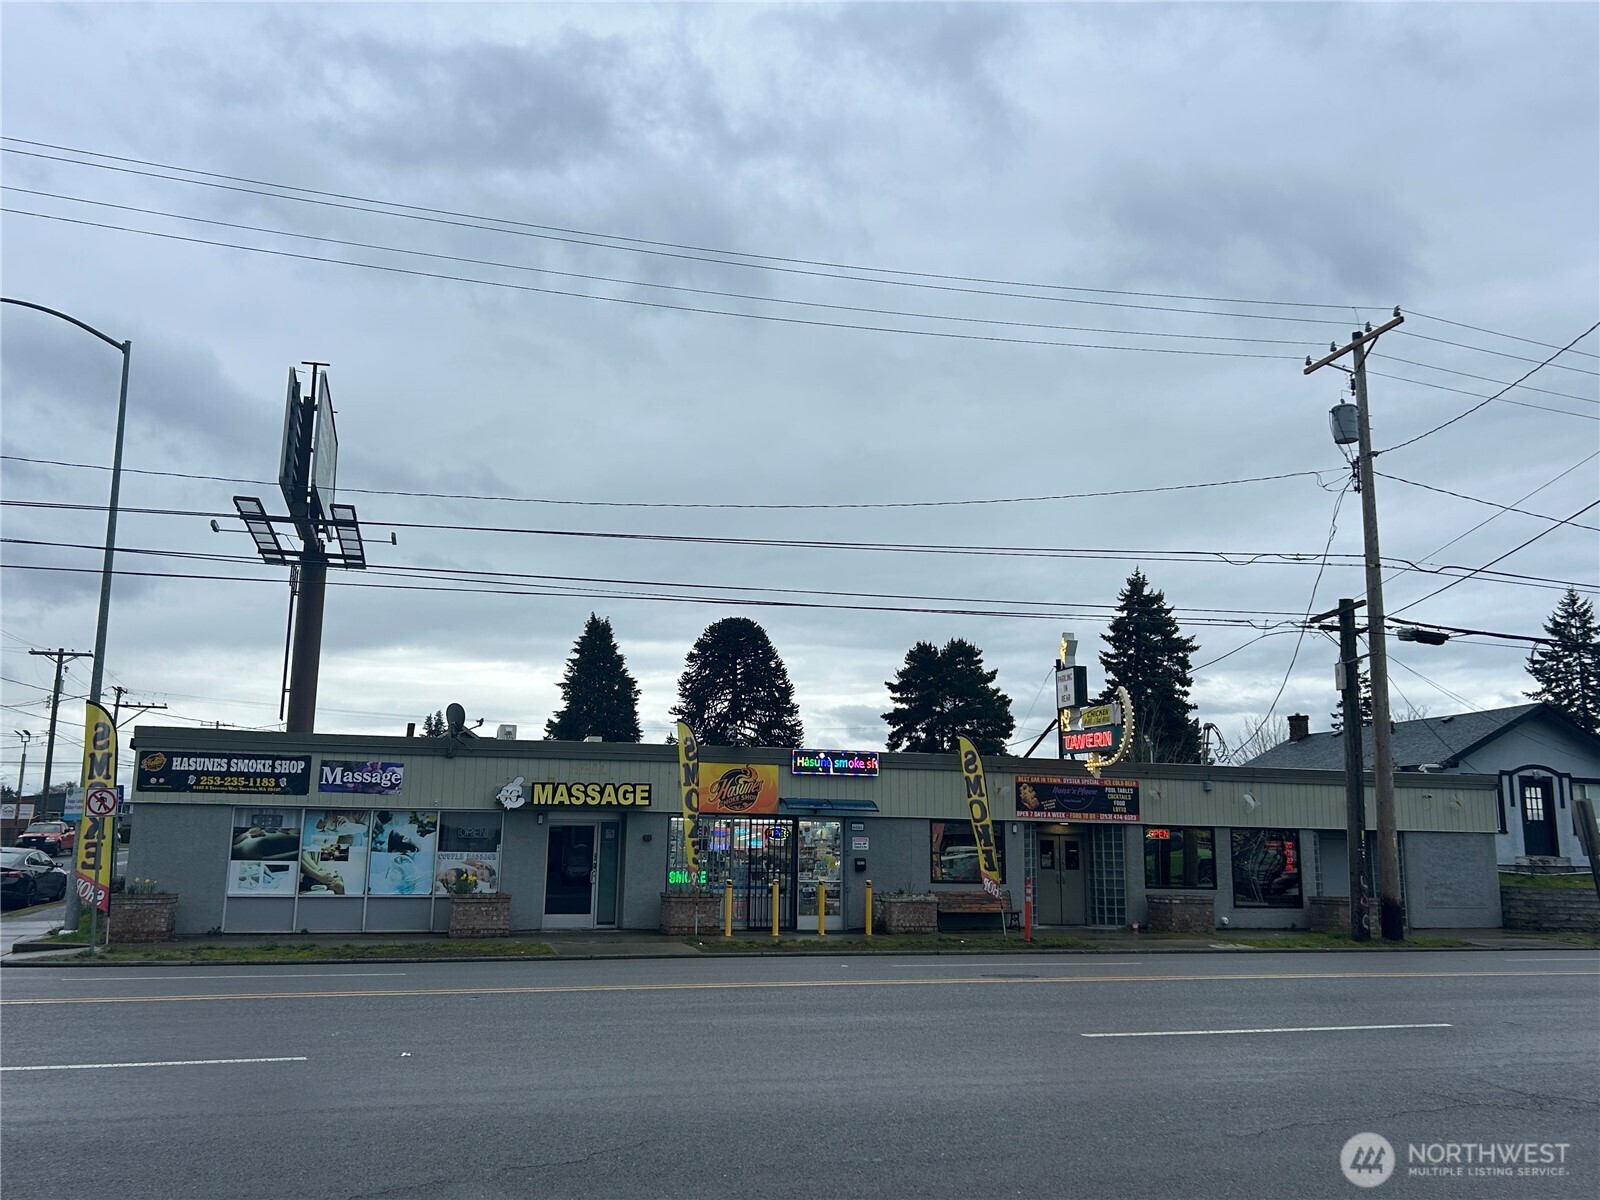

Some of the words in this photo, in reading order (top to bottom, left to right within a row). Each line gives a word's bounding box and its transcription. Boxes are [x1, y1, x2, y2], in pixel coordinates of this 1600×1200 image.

[1063, 731, 1113, 750] TAVERN
[172, 757, 228, 772] HASUNES
[230, 758, 272, 773] SMOKE
[274, 760, 305, 774] SHOP
[834, 757, 865, 769] smoke
[200, 775, 276, 787] 253-235-1183
[320, 766, 401, 787] Massage
[533, 784, 650, 805] MASSAGE
[460, 828, 487, 838] OPEN
[1149, 829, 1170, 839] OPEN
